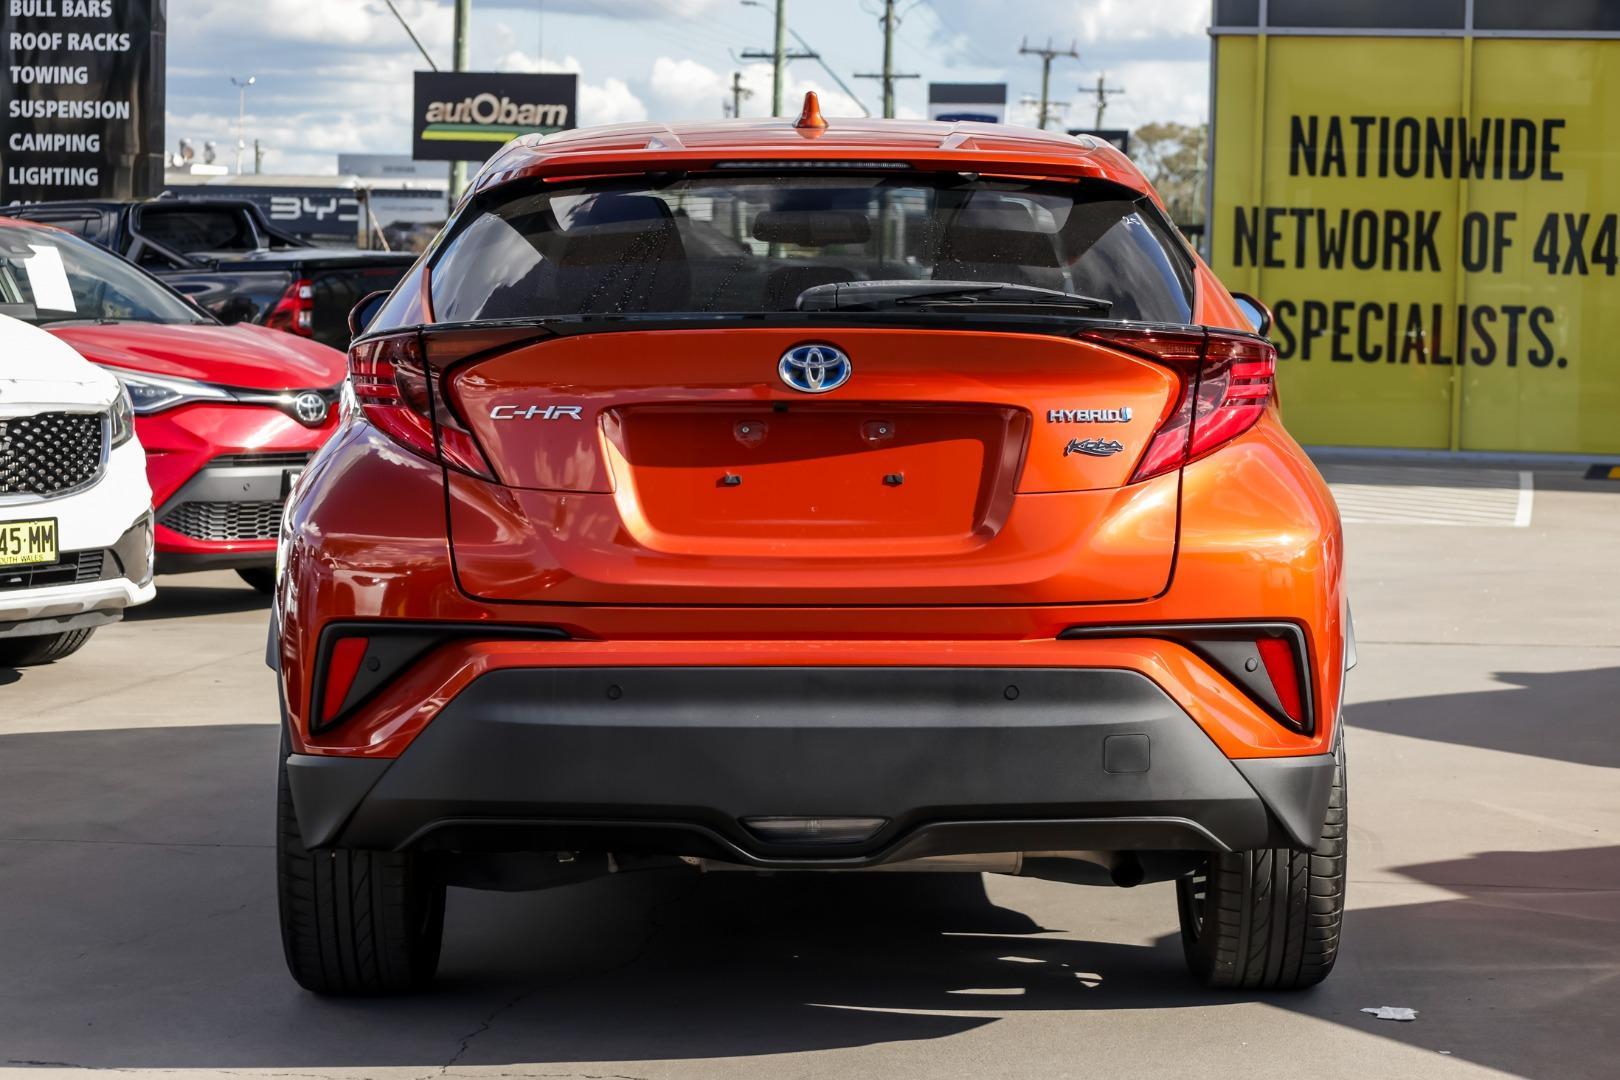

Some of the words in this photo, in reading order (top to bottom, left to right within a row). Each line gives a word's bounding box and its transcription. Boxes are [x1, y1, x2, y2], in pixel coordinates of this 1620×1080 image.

[10, 0, 56, 17] BULL
[62, 0, 112, 17] BARS
[10, 33, 62, 50] ROOF
[67, 33, 130, 51] RACKS
[10, 66, 88, 84] TOWING
[9, 100, 130, 119] SUSPENSION
[9, 133, 100, 152] CAMPING
[1289, 115, 1566, 181] NATIONWIDE
[8, 167, 99, 186] LIGHTING
[1233, 206, 1442, 272] NETWORK
[1461, 211, 1517, 274] OF
[1533, 213, 1618, 276] 4X4
[1273, 299, 1568, 368] SPECIALISTS.
[489, 405, 583, 420] C-HR
[1048, 409, 1121, 422] HYBRID
